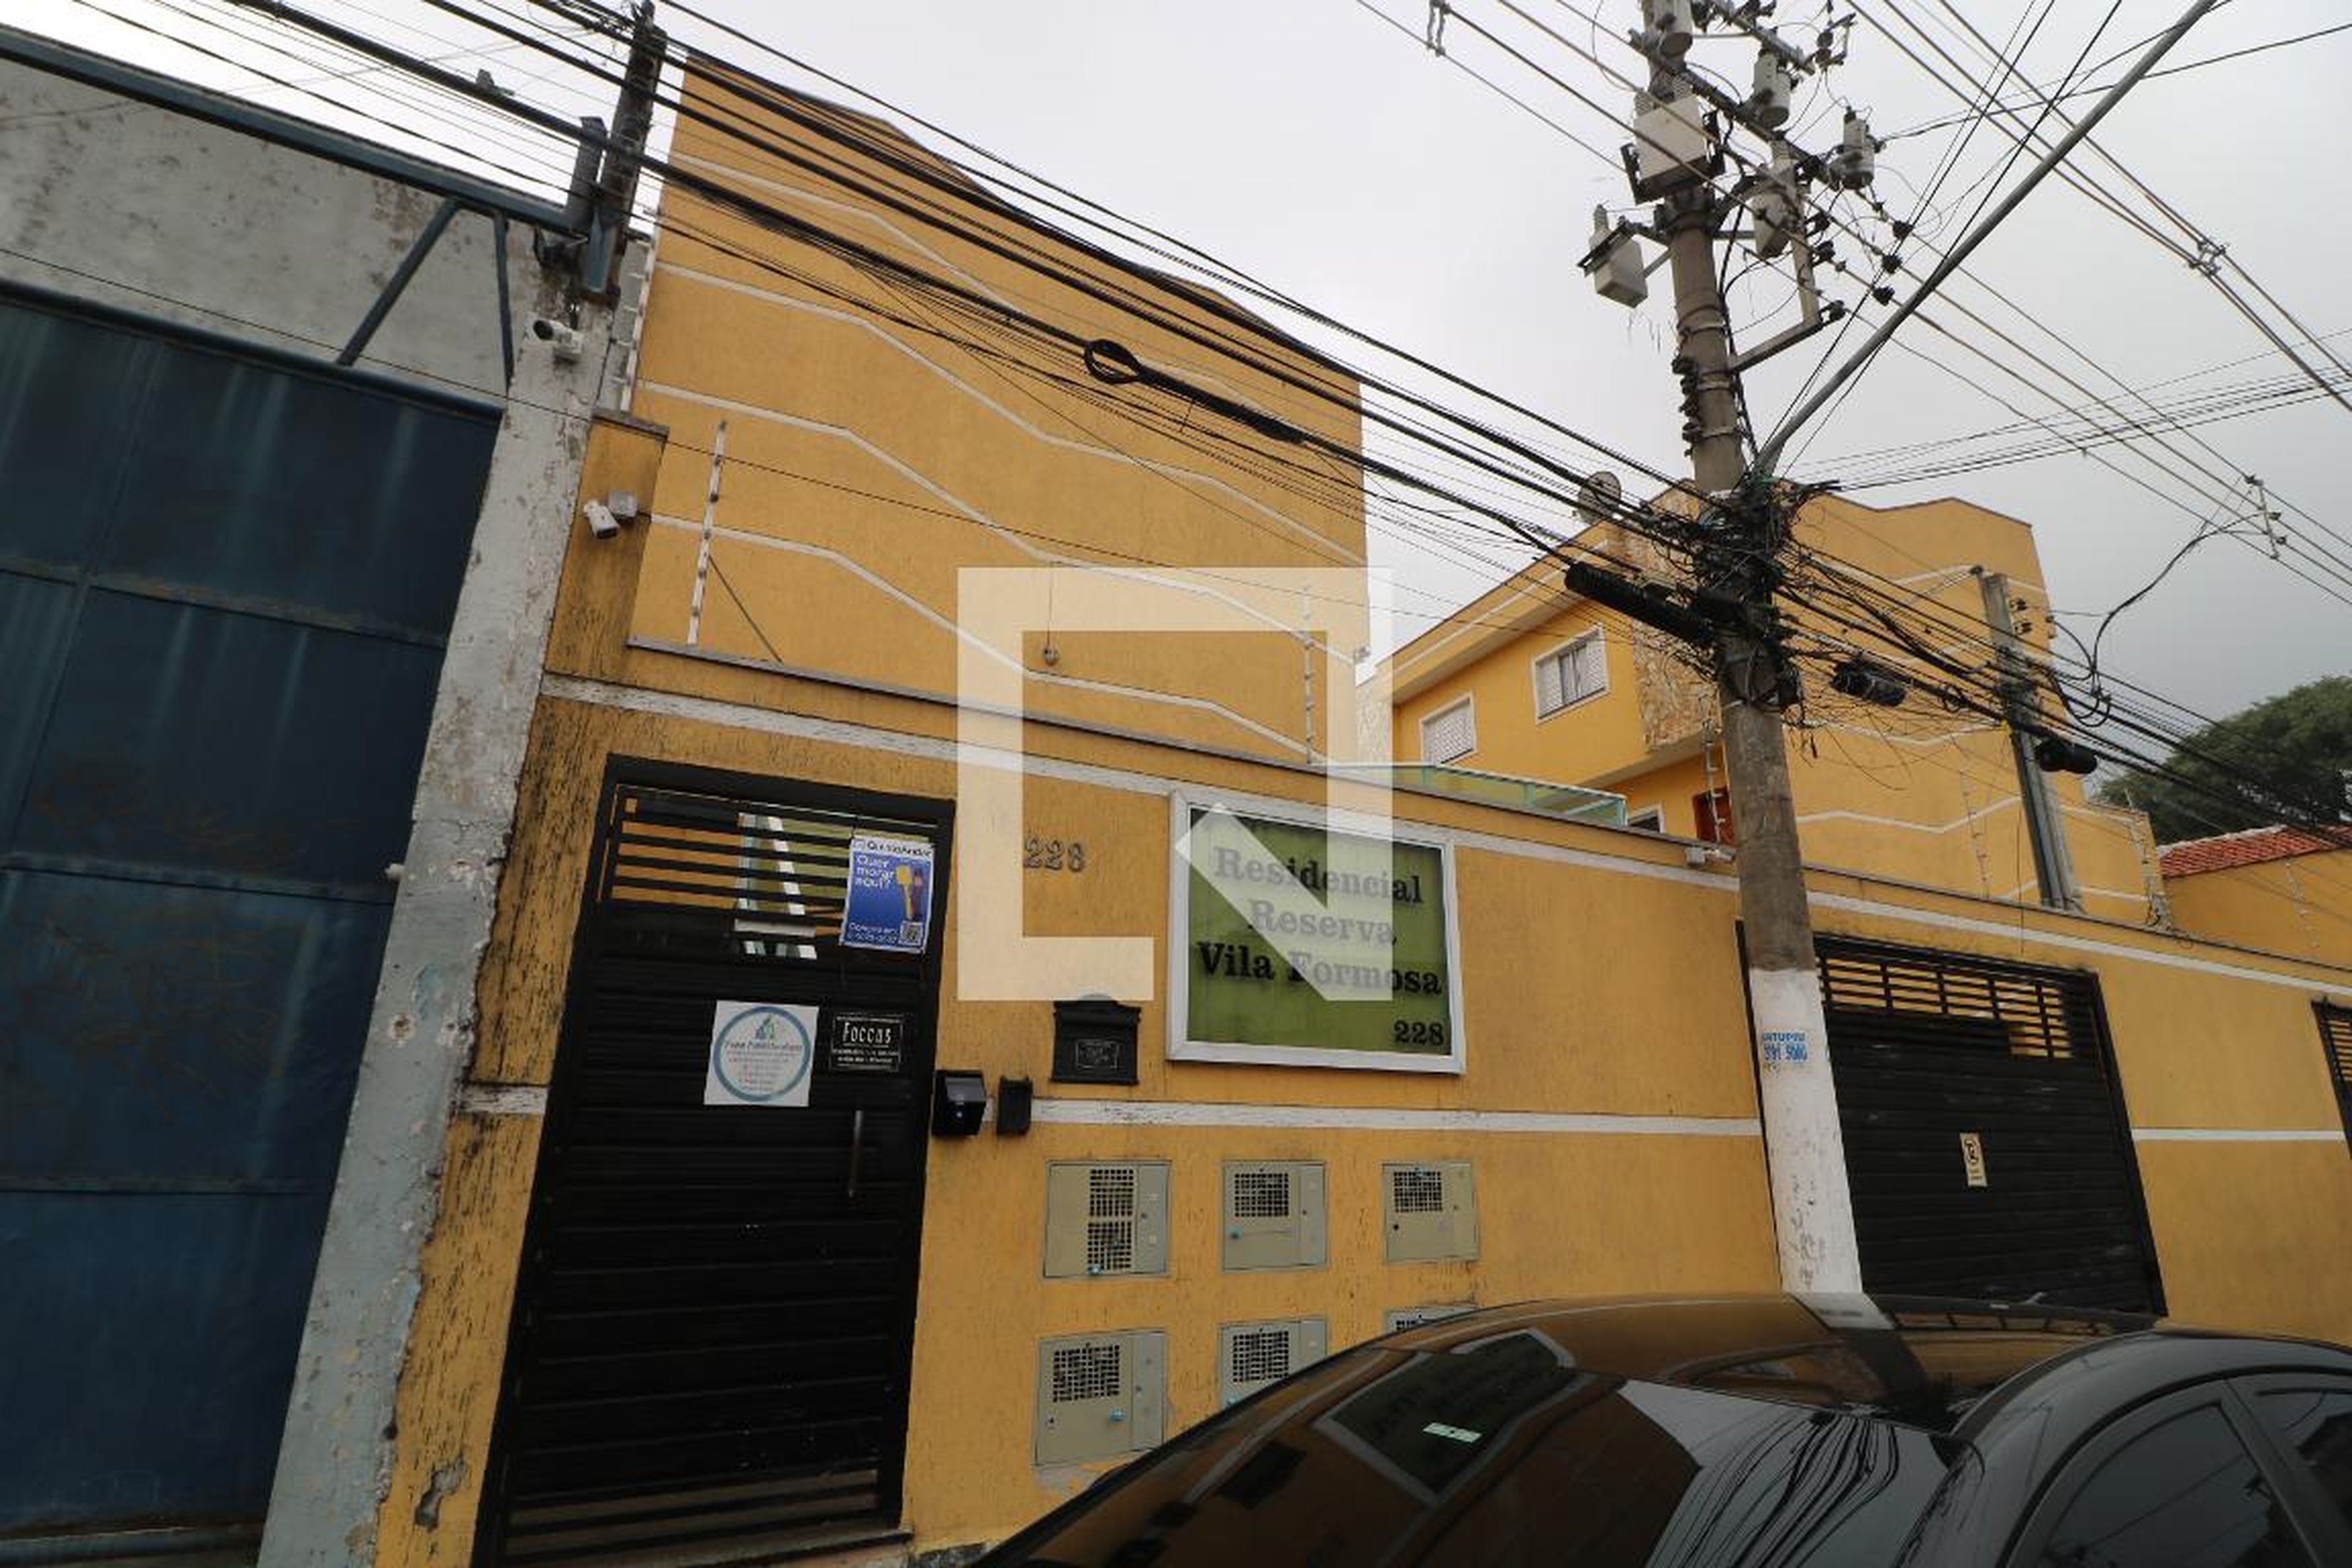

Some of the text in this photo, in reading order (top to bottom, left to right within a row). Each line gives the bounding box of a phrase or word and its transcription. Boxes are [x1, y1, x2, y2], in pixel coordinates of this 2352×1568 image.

[1023, 837, 1085, 872] 228
[1213, 845, 1422, 904] Residencial
[1248, 899, 1396, 948] Reserva
[1196, 942, 1442, 996] Vila Formosa
[1393, 1020, 1444, 1047] 228
